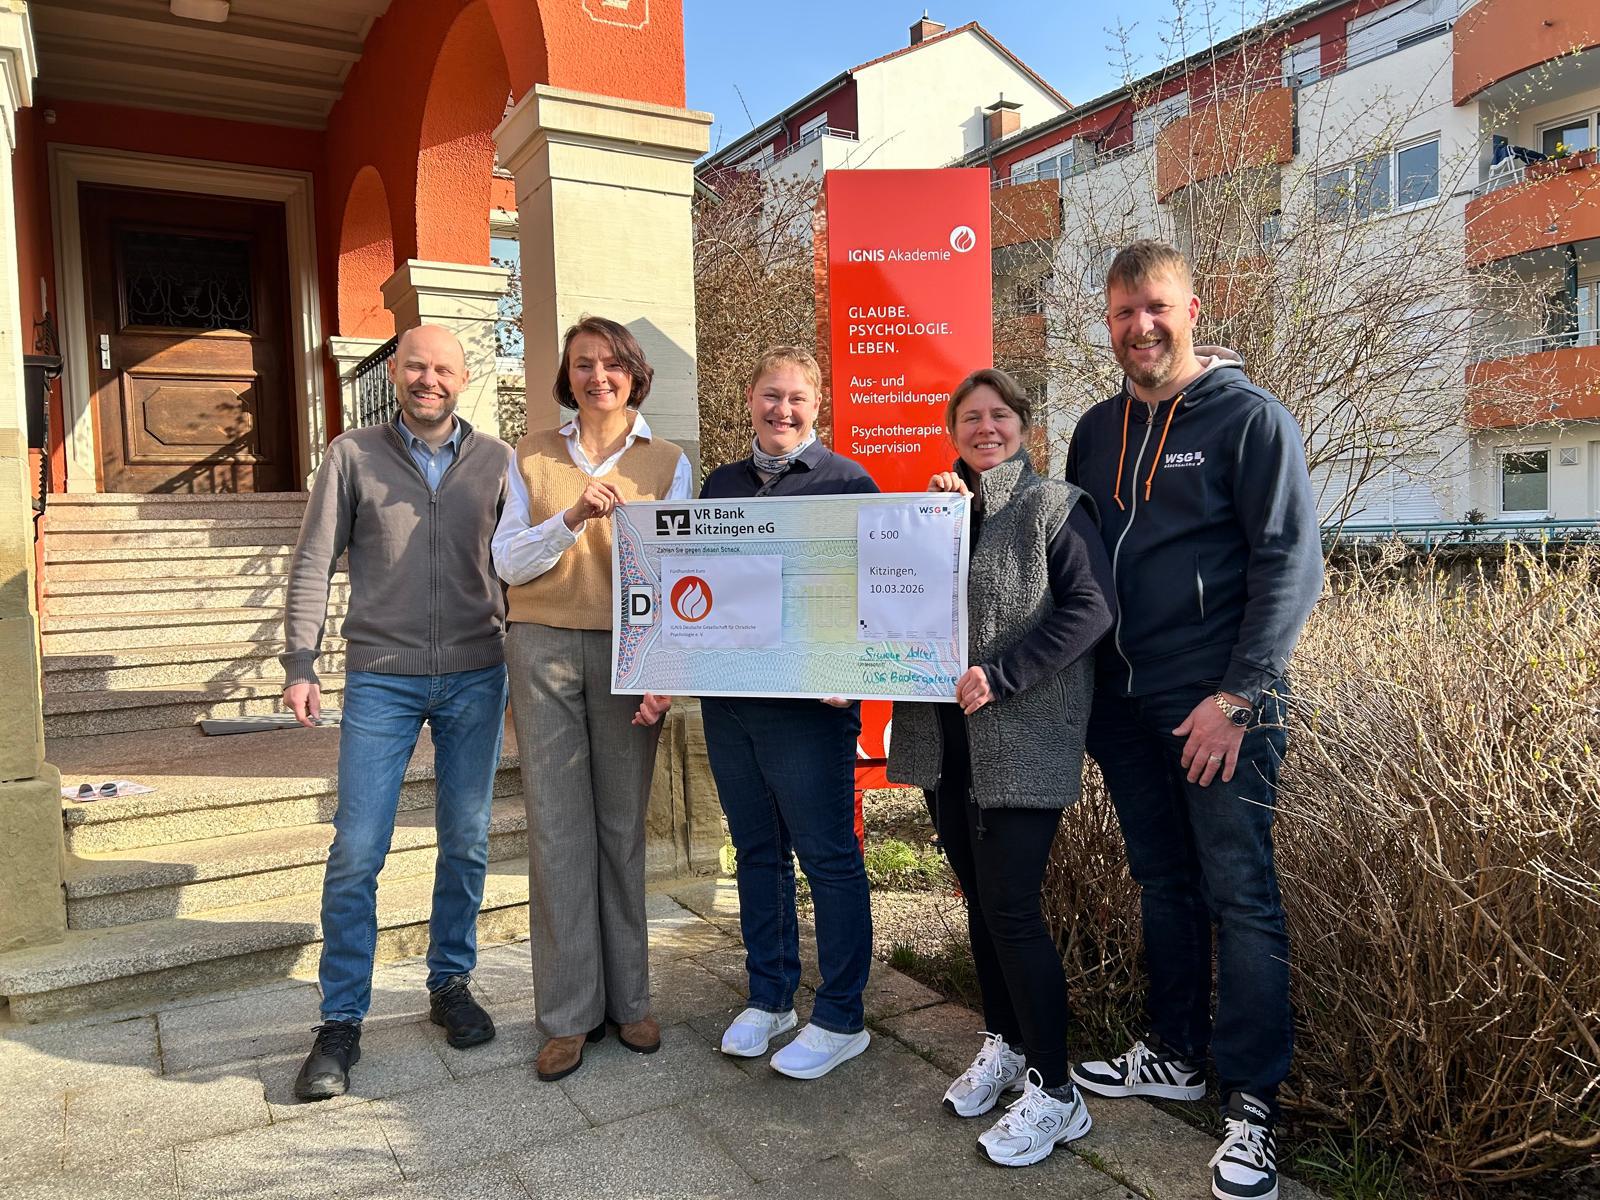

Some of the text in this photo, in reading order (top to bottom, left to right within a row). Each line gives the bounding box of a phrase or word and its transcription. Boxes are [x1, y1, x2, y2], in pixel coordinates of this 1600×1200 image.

[848, 248, 951, 262] IGNIS Akademie
[849, 306, 910, 319] GLAUBE.
[849, 322, 953, 336] PSYCHOLOGIE.
[849, 342, 899, 354] LEBEN.
[850, 374, 905, 387] Aus- und
[850, 391, 951, 405] Weiterbildungen
[851, 424, 942, 440] Psychotherapie
[851, 441, 921, 456] Supervision
[1165, 452, 1194, 463] WSG
[694, 507, 745, 519] VR Bank
[919, 506, 941, 514] WSG
[695, 522, 775, 537] Kitzingen eG
[869, 530, 899, 540] € 500
[869, 566, 917, 578] Kitzingen,
[870, 584, 925, 594] 10.03.2026
[631, 593, 651, 616] D
[1243, 1104, 1267, 1120] adidas
[1037, 1116, 1057, 1134] N
